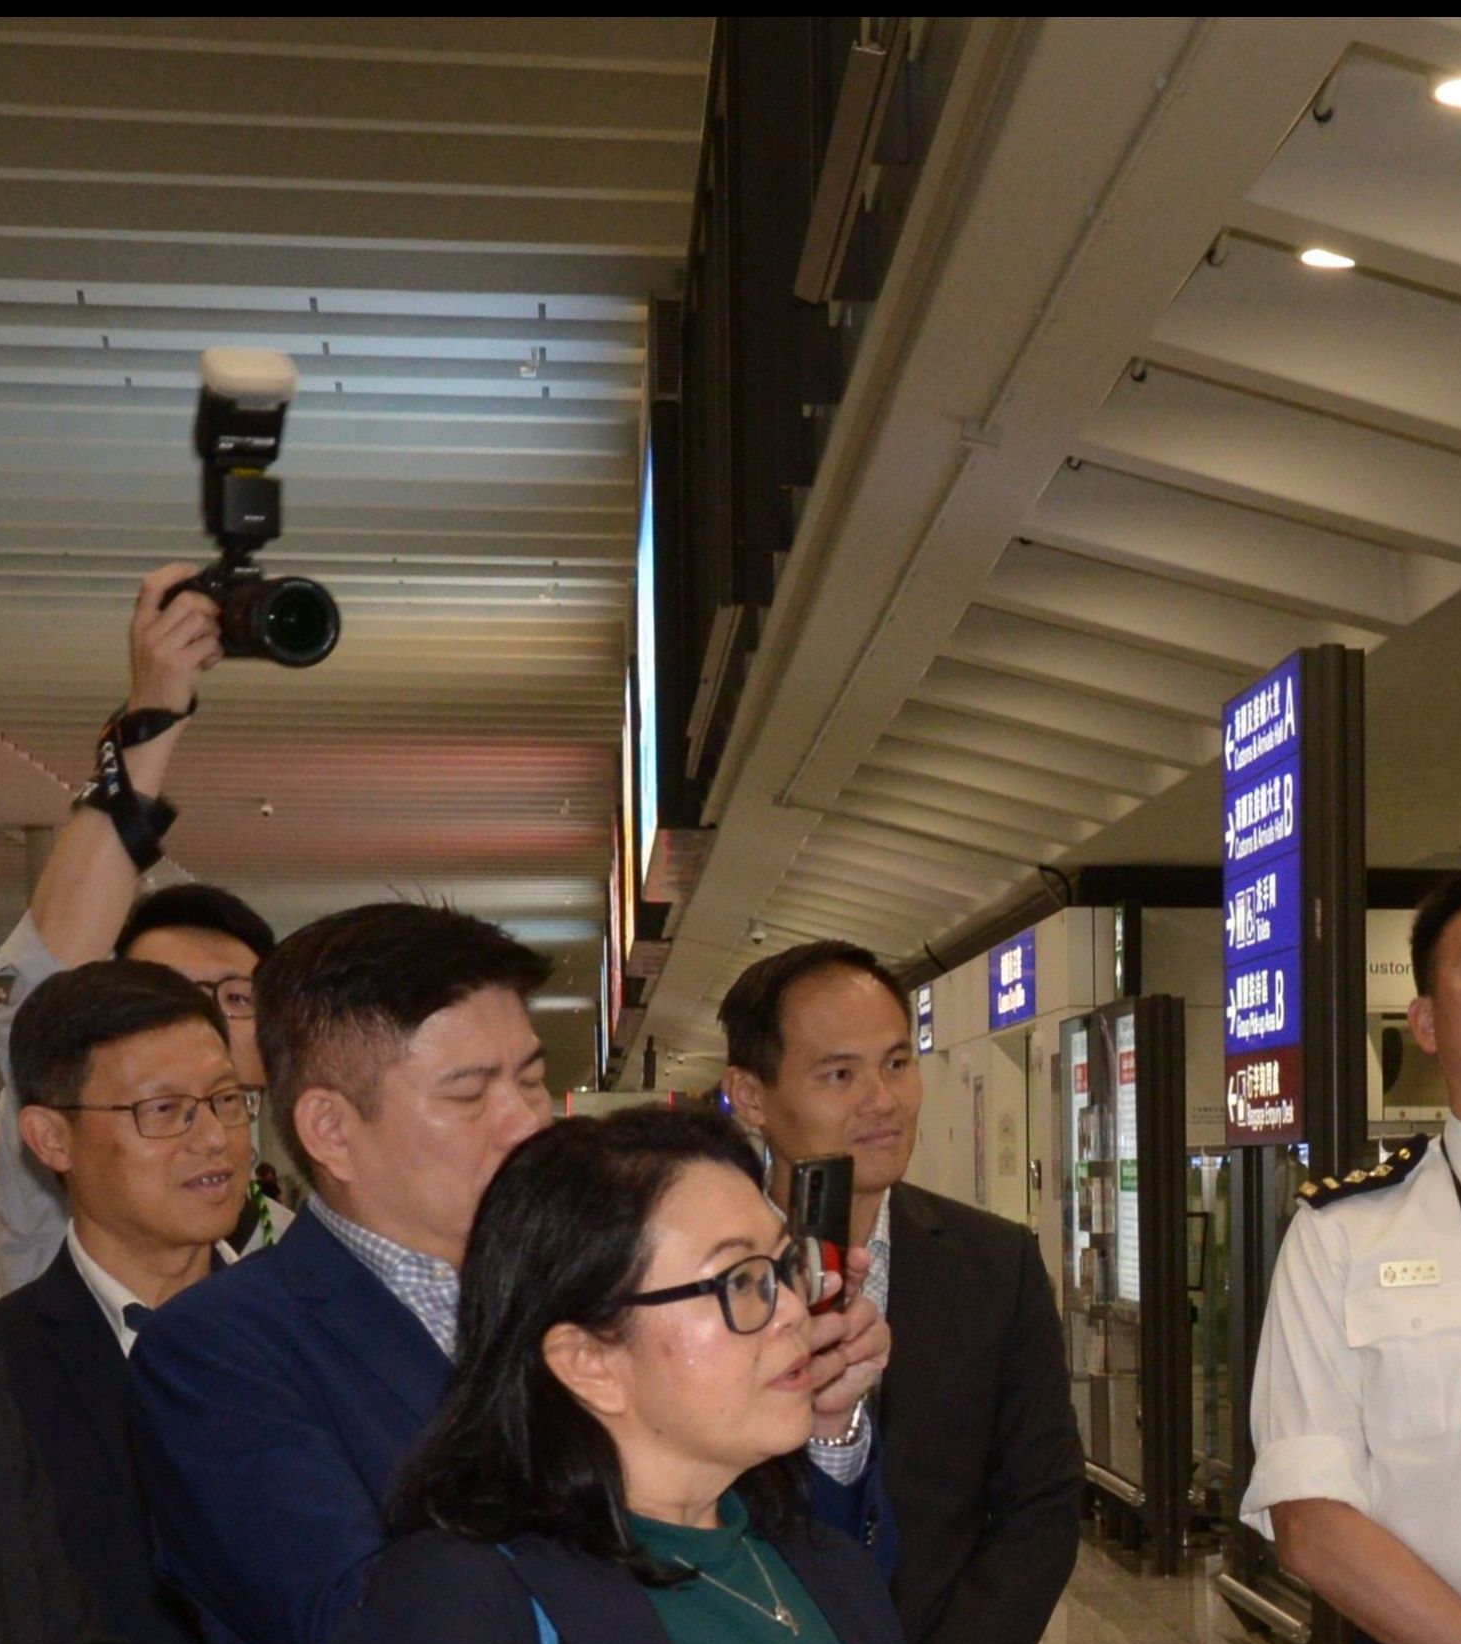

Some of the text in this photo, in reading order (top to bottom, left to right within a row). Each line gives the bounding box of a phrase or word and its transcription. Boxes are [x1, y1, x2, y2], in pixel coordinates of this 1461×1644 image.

[1284, 675, 1296, 742] A
[1283, 772, 1294, 838] B
[1274, 969, 1284, 1031] B
